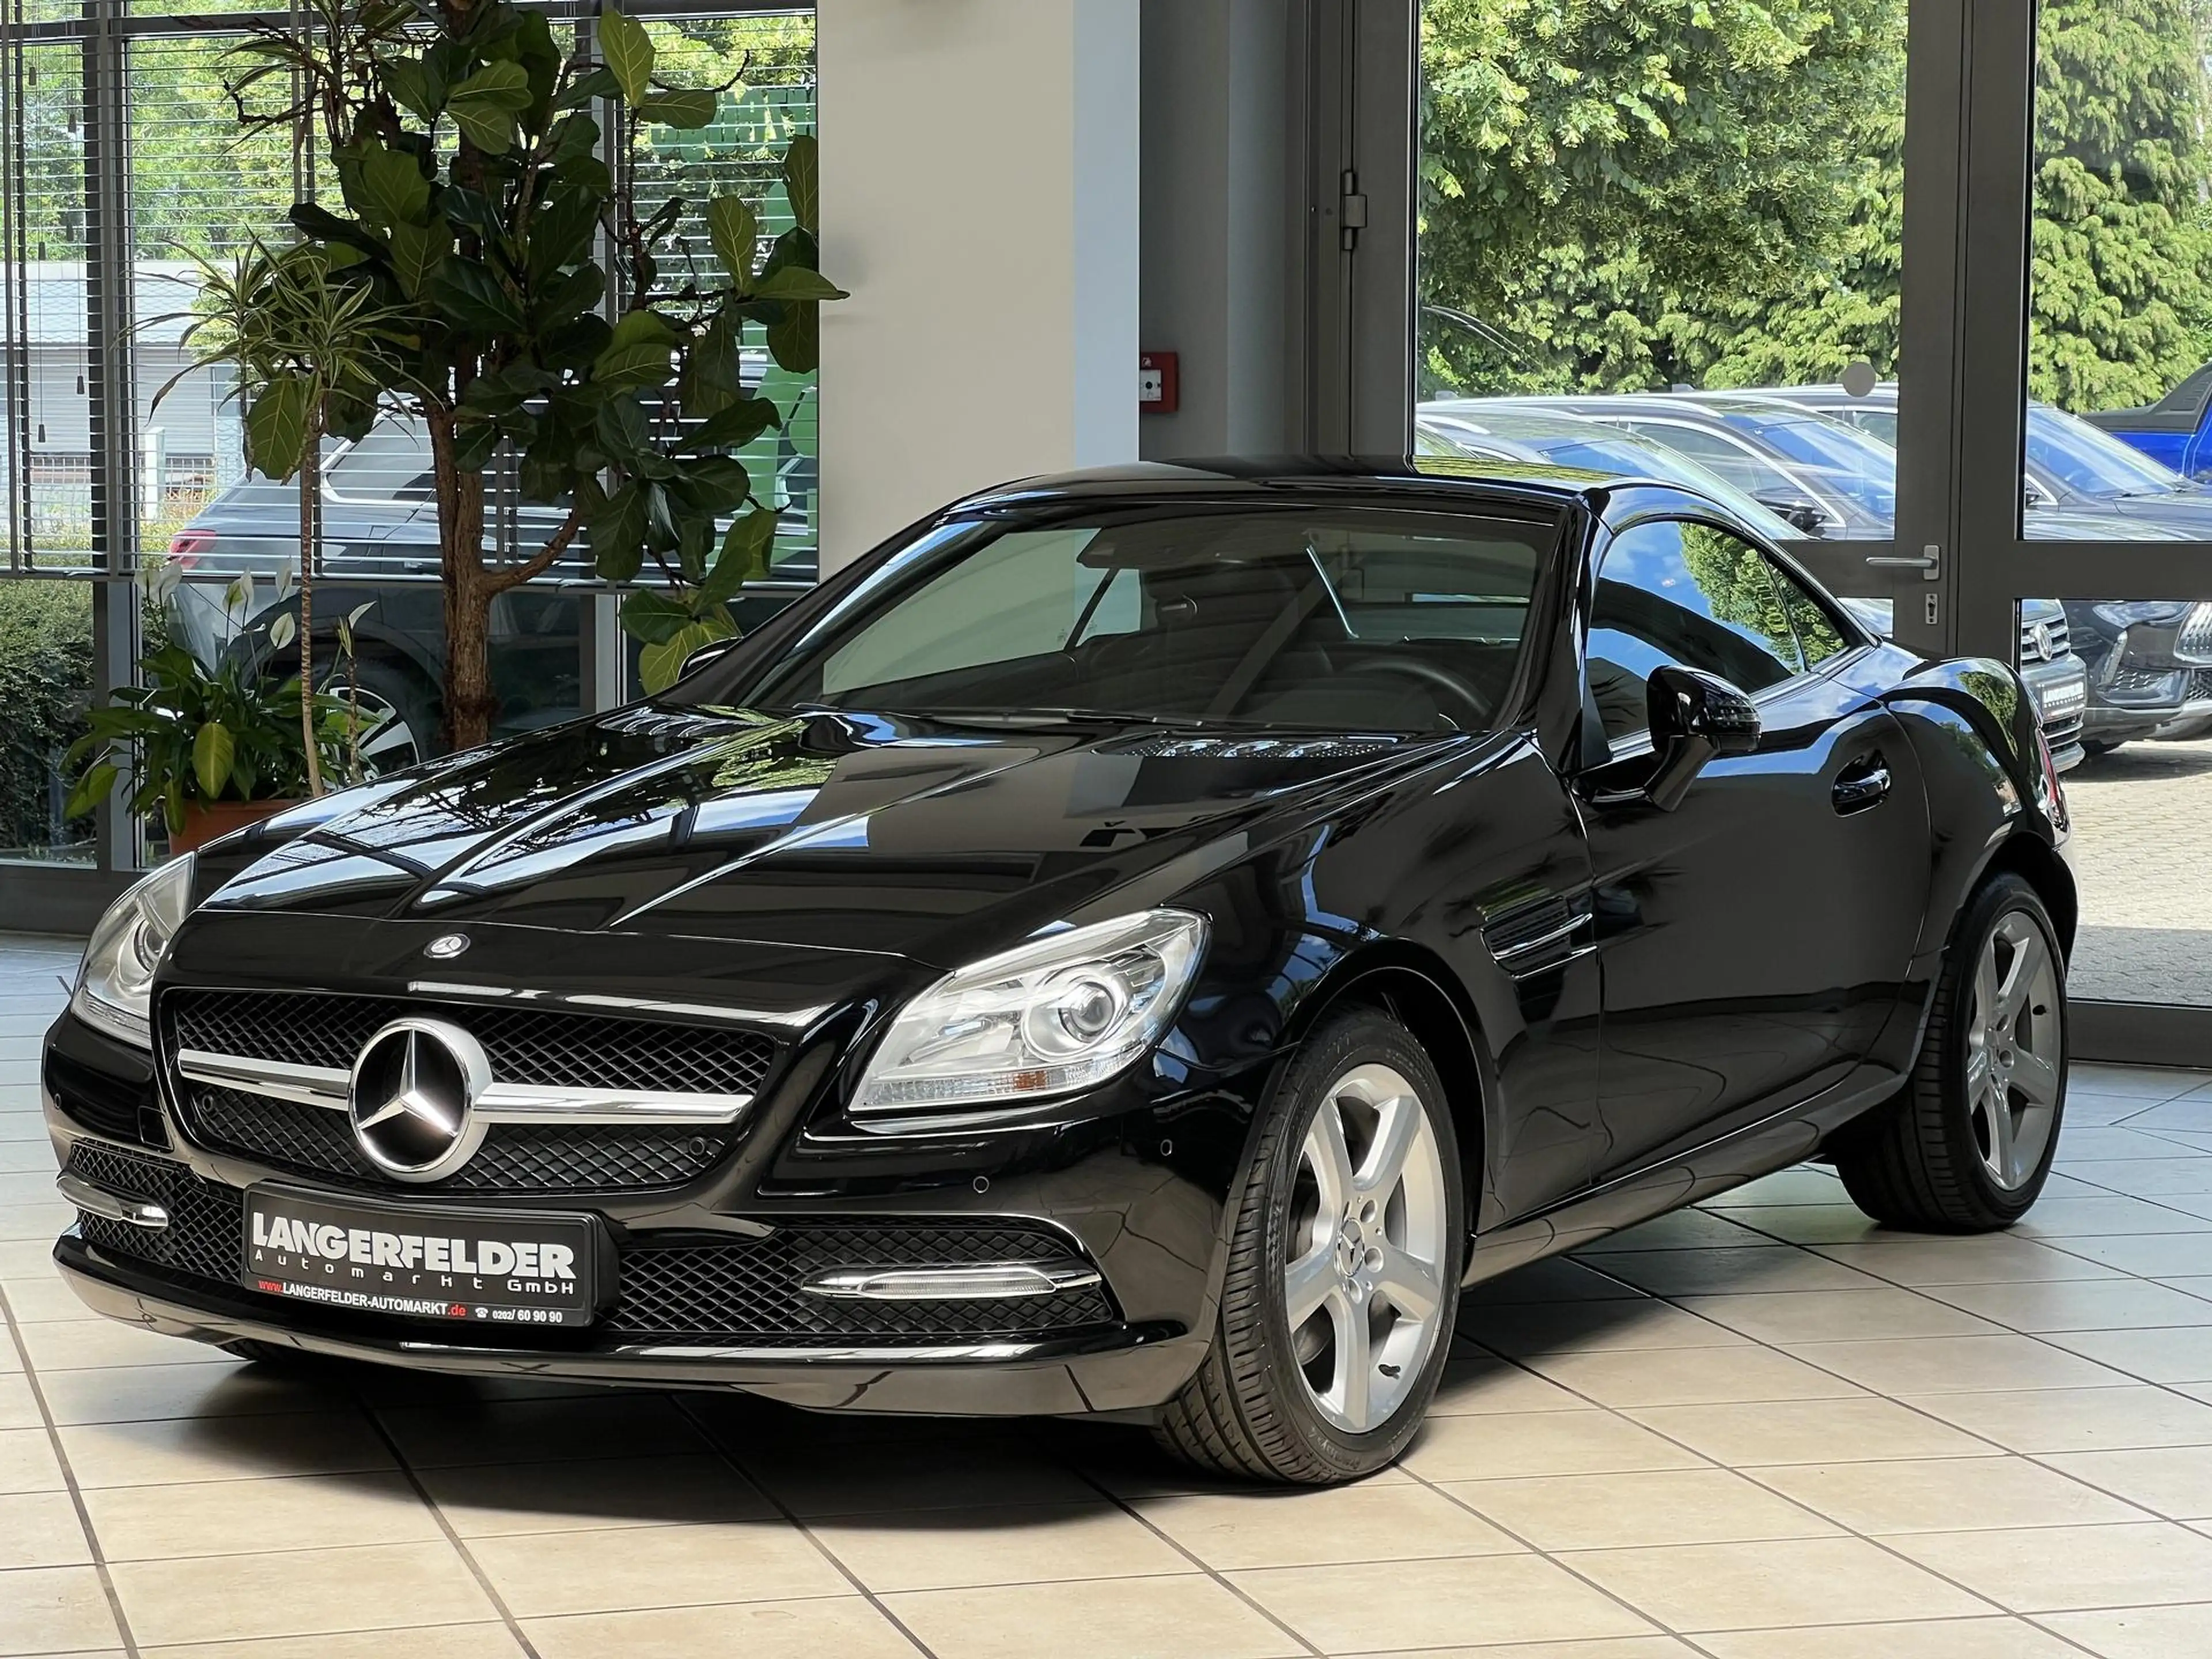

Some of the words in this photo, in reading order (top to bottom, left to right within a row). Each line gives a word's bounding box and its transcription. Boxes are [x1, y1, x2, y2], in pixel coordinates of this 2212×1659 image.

[253, 1211, 577, 1279] LANGERFELDER
[258, 1280, 467, 1317] www.LANGERFELDER-AUTOMARKT.de
[507, 1279, 574, 1295] GmbH
[517, 1309, 532, 1321] 60
[533, 1310, 548, 1322] 90
[549, 1311, 563, 1323] 90
